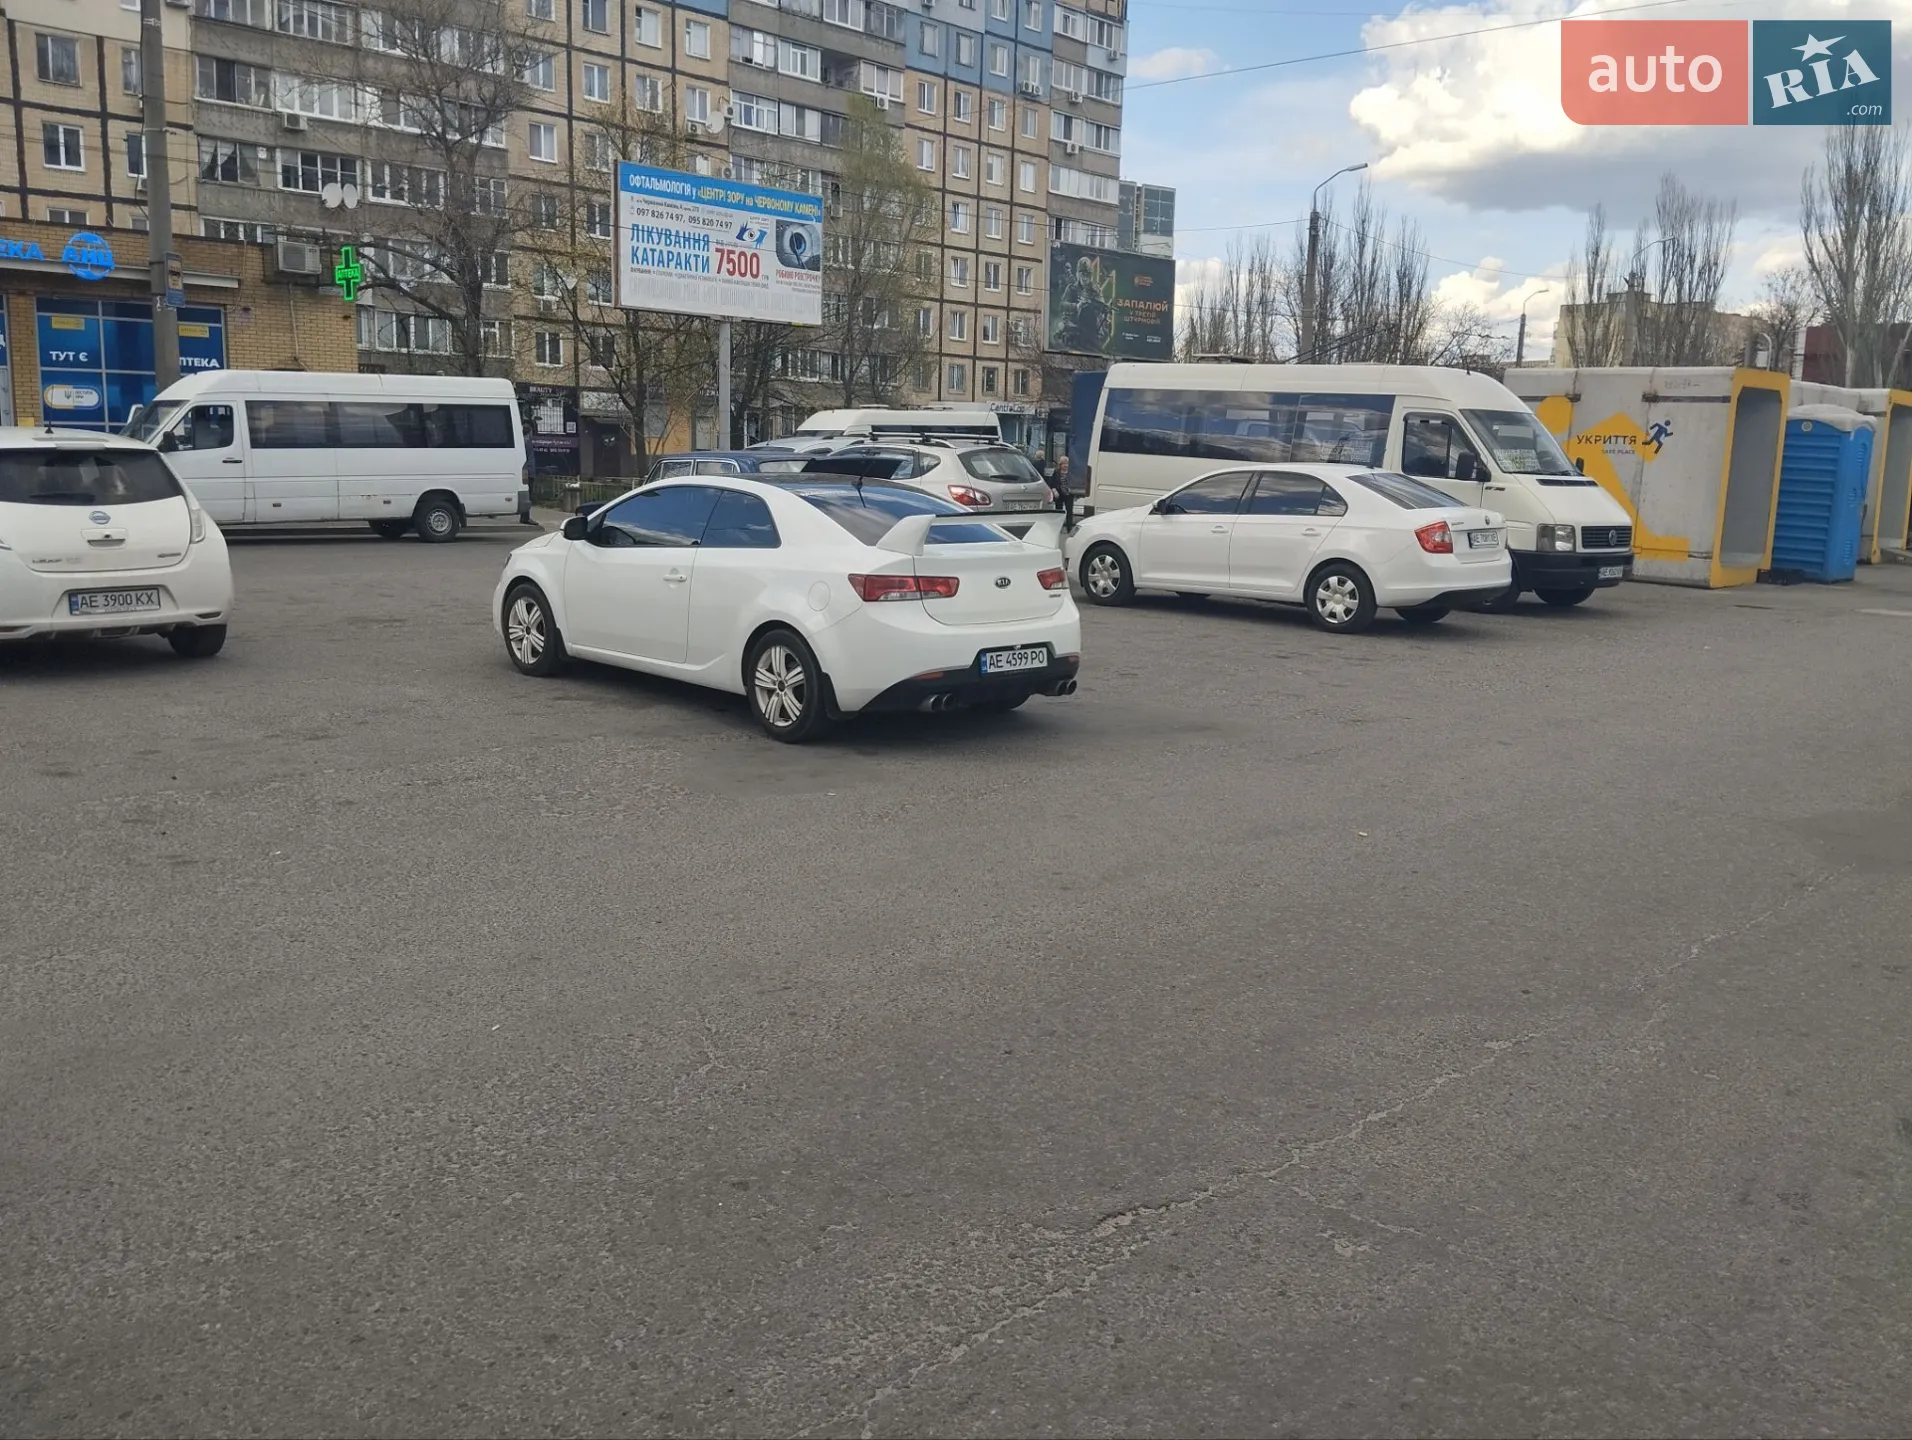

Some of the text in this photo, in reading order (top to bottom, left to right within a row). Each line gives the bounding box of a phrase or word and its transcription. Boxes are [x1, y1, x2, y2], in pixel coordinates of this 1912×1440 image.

[629, 174, 691, 196] ОФТАЛЬМОЛОГІЯ
[727, 190, 745, 204] ЗОРУ
[755, 196, 794, 212] ЧЕРВОНОМУ
[636, 207, 649, 217] 097
[650, 209, 664, 219] 826
[665, 211, 674, 221] 74
[688, 215, 700, 225] 095
[715, 219, 724, 228] 74
[725, 220, 734, 230] 97
[630, 223, 710, 252] ЛІКУВАННЯ
[631, 245, 710, 273] КАТАРАКТИ
[715, 247, 760, 279] 7500
[1117, 298, 1168, 312] ЗАПАЛЮЙ
[50, 351, 89, 362] ТУТ Є
[179, 356, 220, 369] ПТЕКА
[1576, 434, 1637, 445] УКРИТТЯ
[80, 590, 155, 608] AE 3900 KX
[988, 650, 1045, 669] AE 4599 PO
